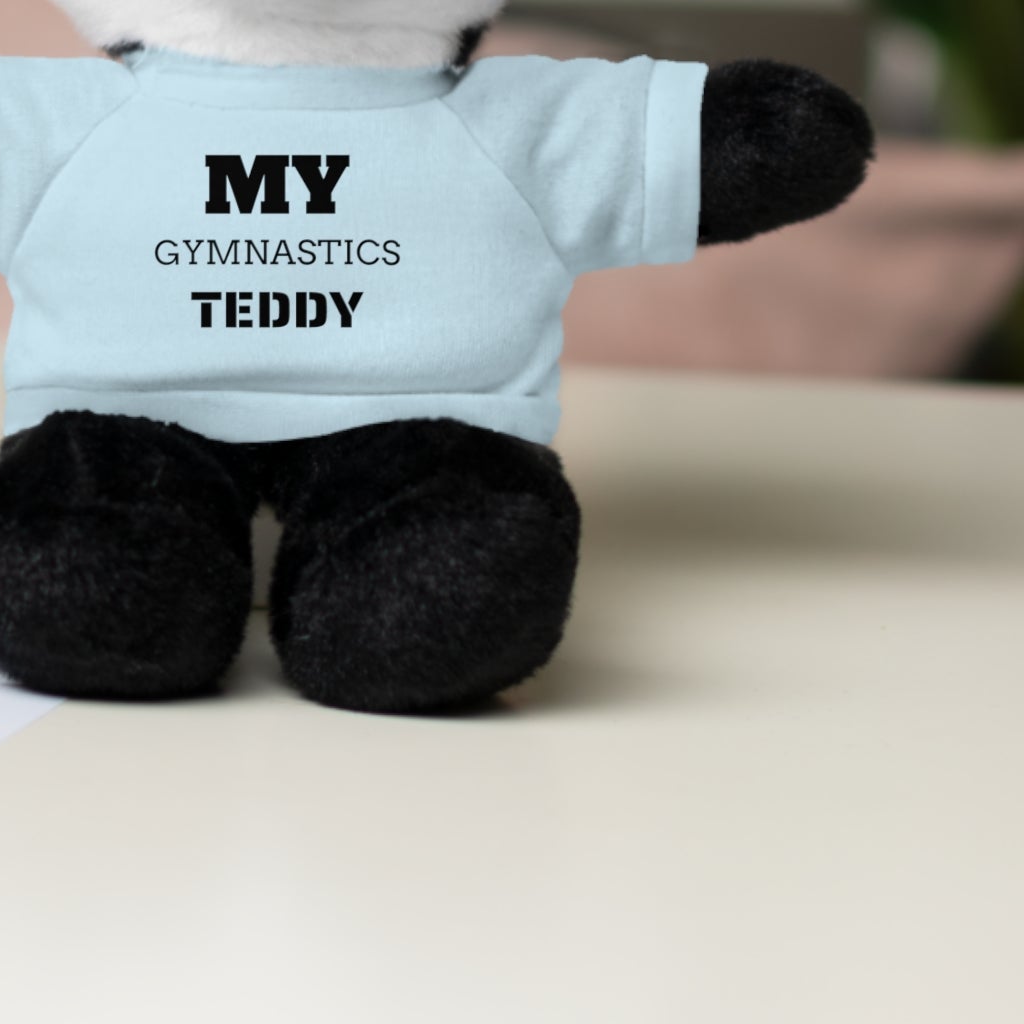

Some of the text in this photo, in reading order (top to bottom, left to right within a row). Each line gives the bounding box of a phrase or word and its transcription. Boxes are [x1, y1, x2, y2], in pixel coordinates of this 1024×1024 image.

[205, 154, 350, 214] MY
[154, 239, 401, 266] GYMNASTICS
[191, 291, 364, 328] TEDDY
